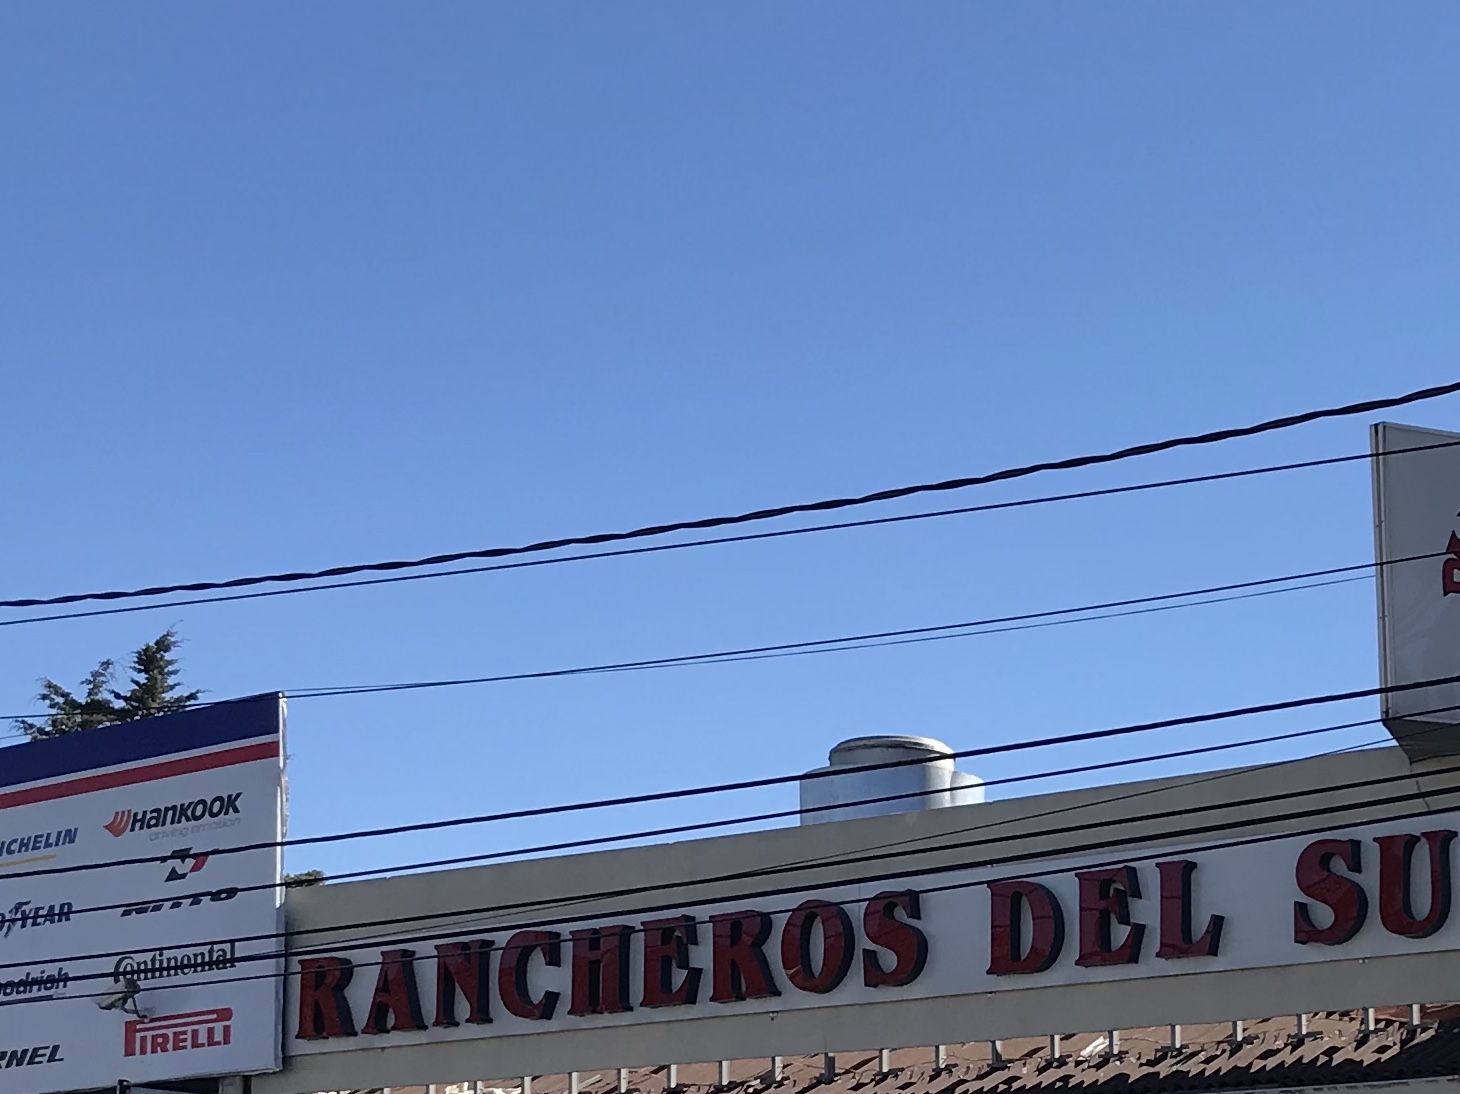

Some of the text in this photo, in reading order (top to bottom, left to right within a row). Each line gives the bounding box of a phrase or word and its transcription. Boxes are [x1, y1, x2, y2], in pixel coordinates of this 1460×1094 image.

[113, 941, 237, 984] Continental
[295, 888, 928, 1040] RANCHEROS
[986, 859, 1225, 976] DEL
[124, 1007, 233, 1057] PIRELLI
